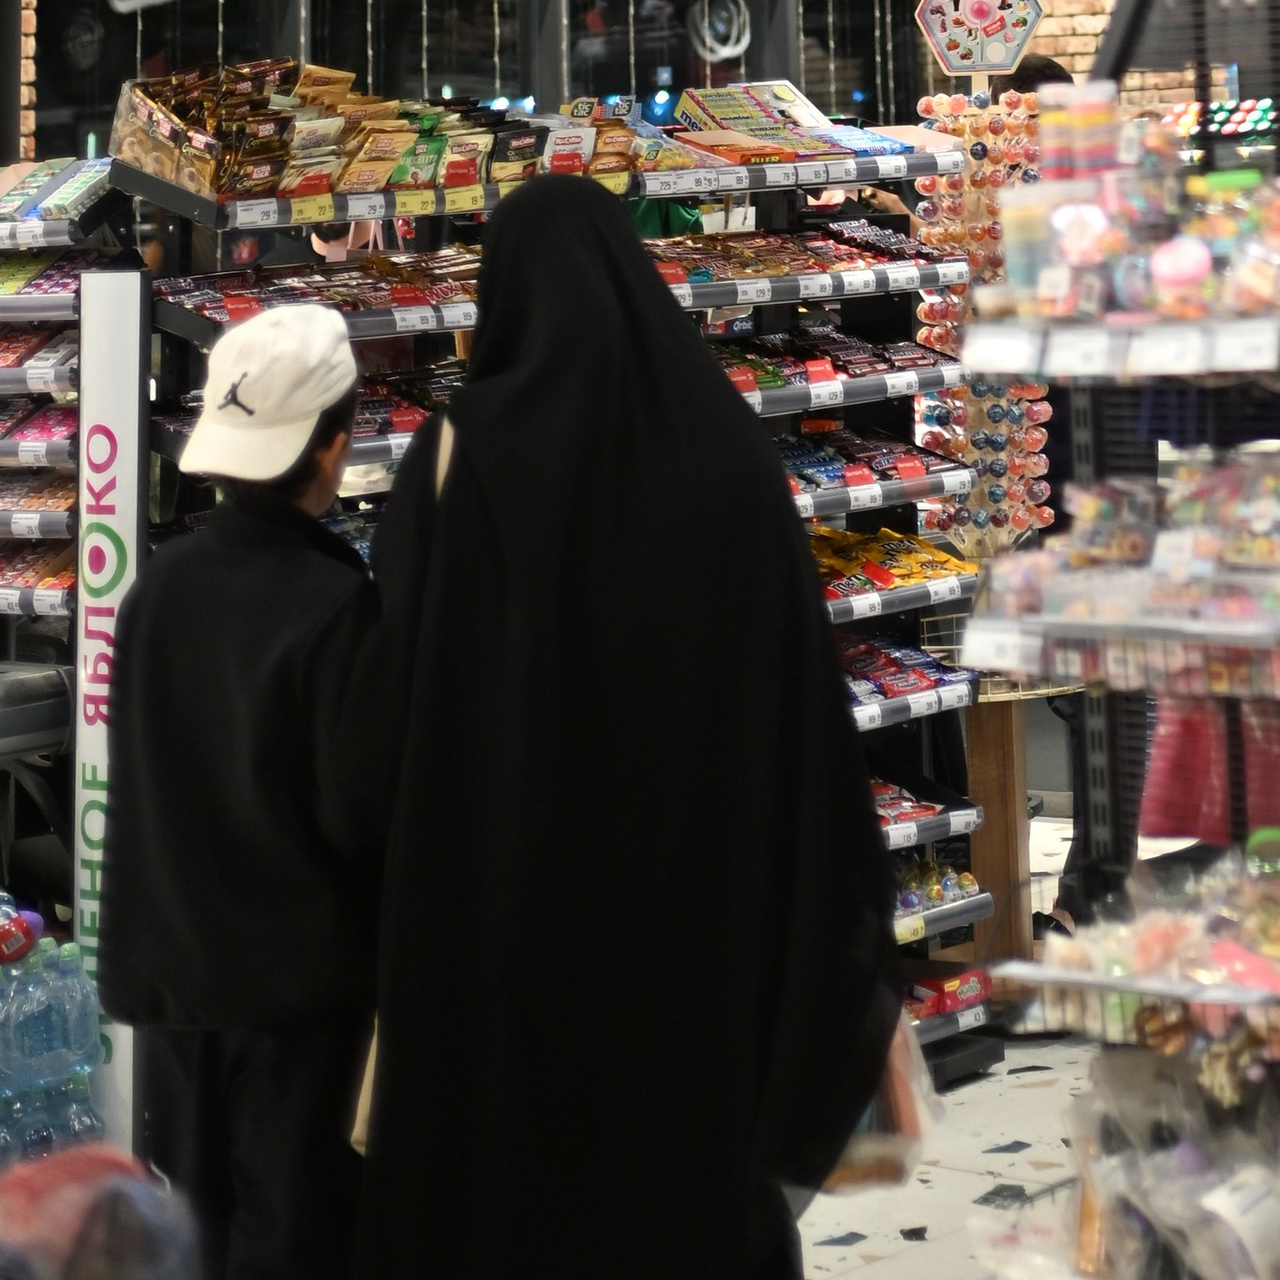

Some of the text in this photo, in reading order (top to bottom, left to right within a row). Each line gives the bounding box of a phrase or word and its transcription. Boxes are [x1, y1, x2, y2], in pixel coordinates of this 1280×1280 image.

[577, 102, 591, 111] tic
[619, 100, 630, 109] tic
[573, 108, 589, 116] tac
[614, 107, 628, 115] tac
[679, 110, 703, 132] me
[783, 172, 790, 181] 79
[660, 181, 671, 190] 225
[368, 205, 376, 214] 29
[421, 201, 429, 210] 22
[318, 206, 326, 215] 22
[261, 211, 270, 220] 29
[733, 321, 753, 331] Orbit
[81, 424, 128, 727] ЯБЛОКО
